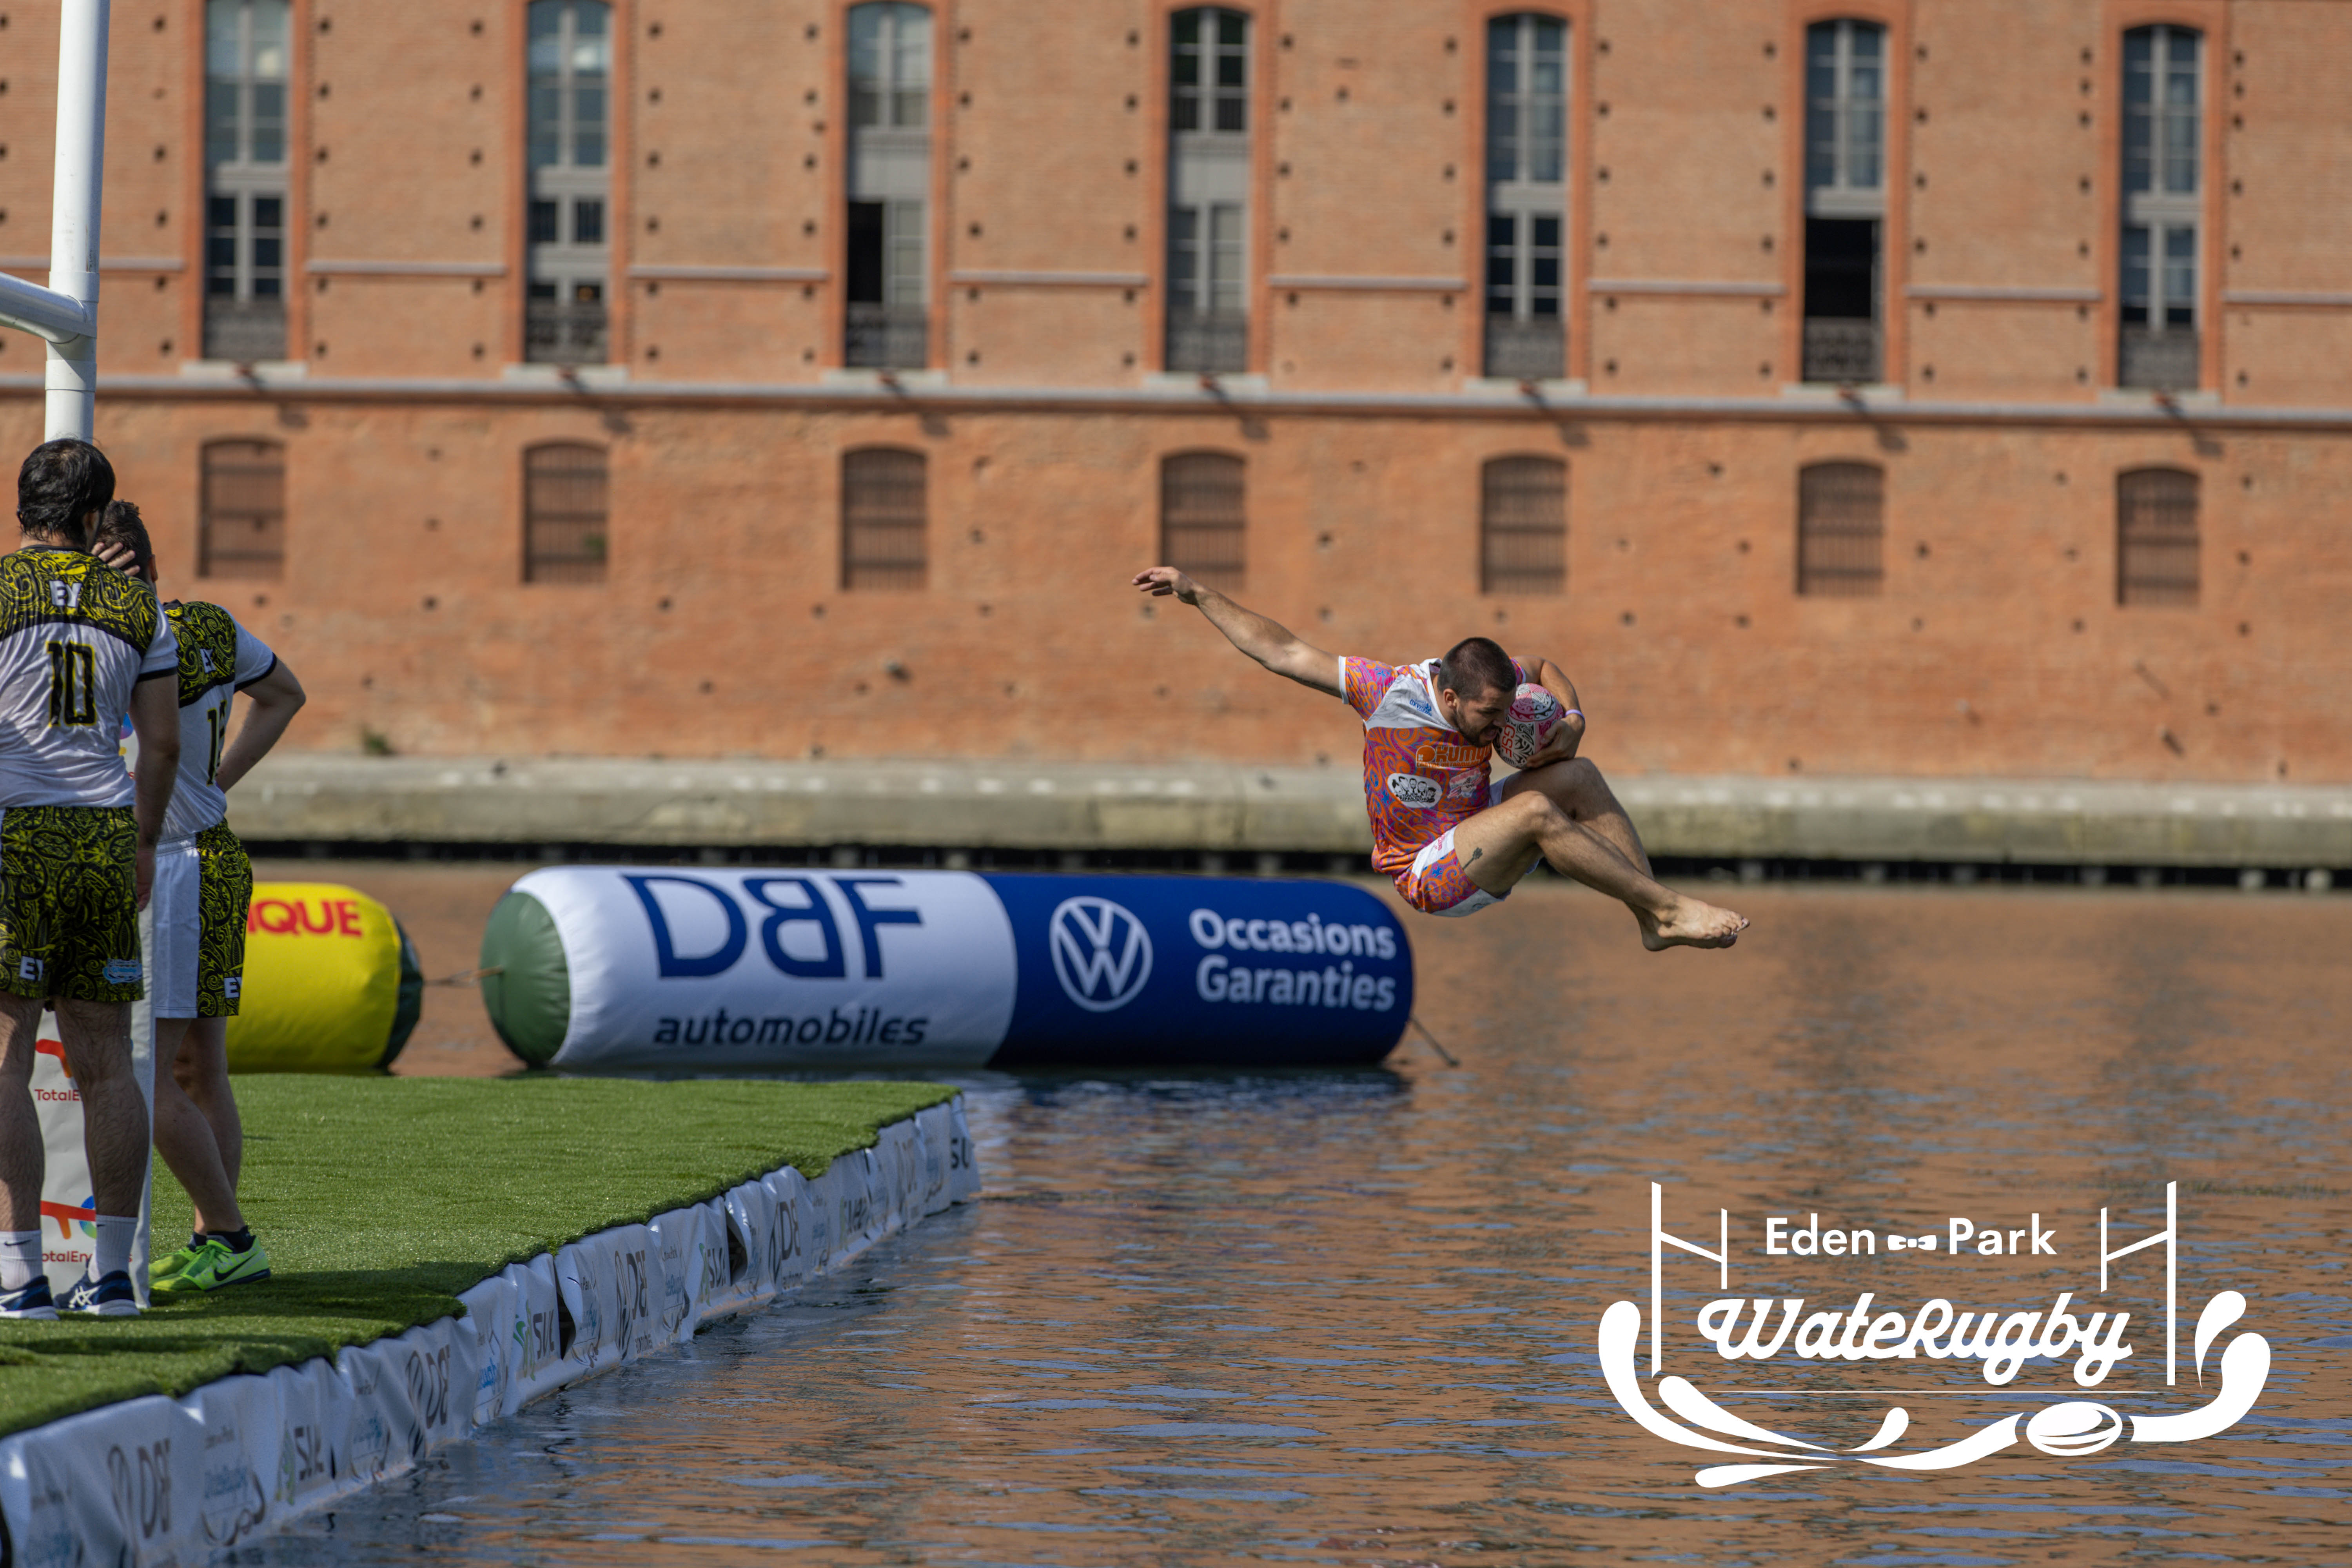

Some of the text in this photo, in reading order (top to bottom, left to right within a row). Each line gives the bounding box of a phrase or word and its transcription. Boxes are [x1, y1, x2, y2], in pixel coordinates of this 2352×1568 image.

[49, 581, 82, 607] EY
[45, 640, 96, 726] 10
[207, 699, 227, 786] 1
[248, 899, 363, 938] IQUE
[617, 873, 924, 980] DBF
[1189, 908, 1396, 959] Occasions
[224, 976, 242, 998] E
[1196, 955, 1396, 1011] Garanties
[654, 1006, 930, 1046] automobiles
[35, 1089, 80, 1101] TotalE
